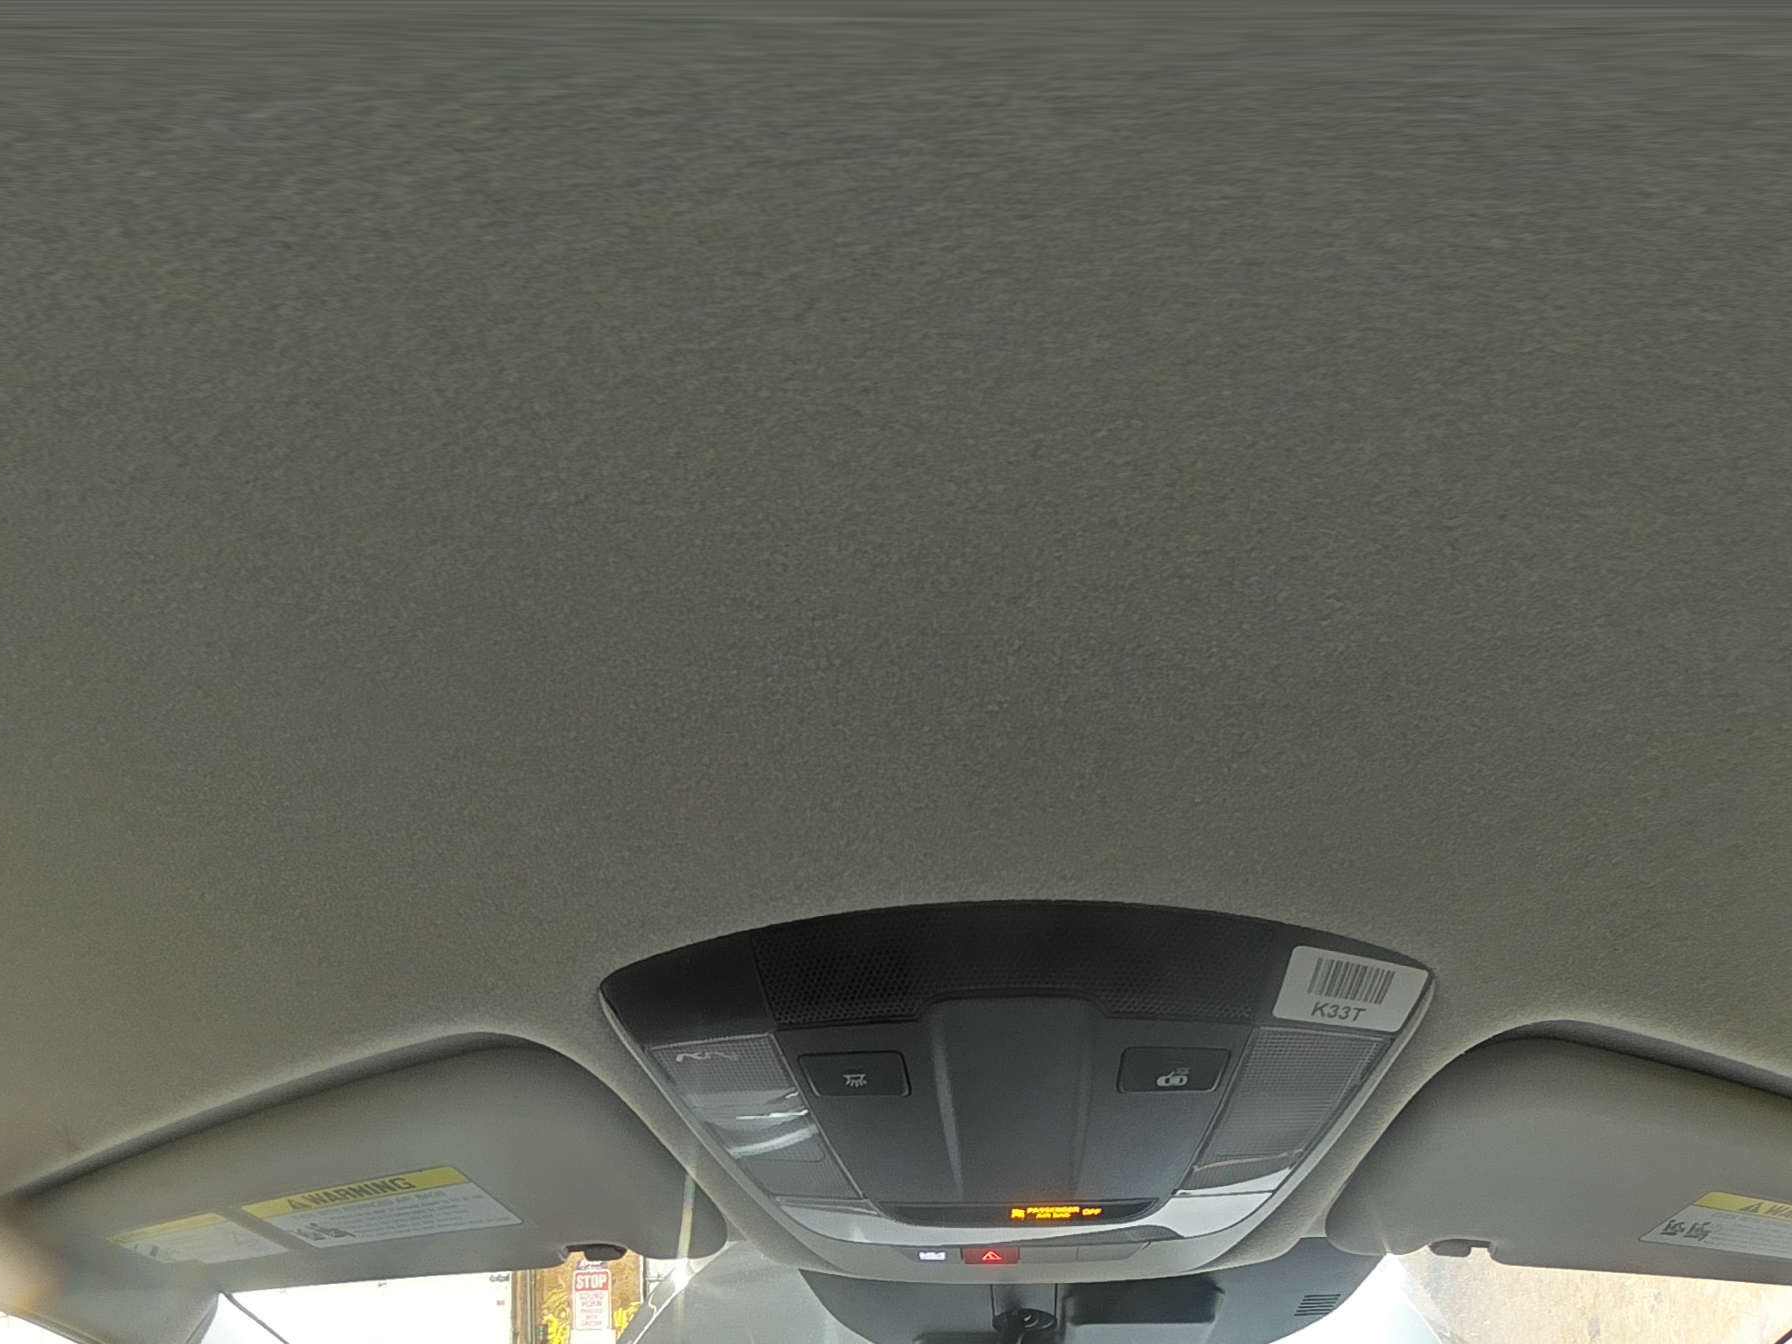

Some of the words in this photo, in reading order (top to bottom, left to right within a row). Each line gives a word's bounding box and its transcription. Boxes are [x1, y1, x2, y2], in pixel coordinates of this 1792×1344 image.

[1311, 1001, 1367, 1022] K33T
[303, 1177, 416, 1206] WARNING
[576, 1274, 607, 1290] STOP
